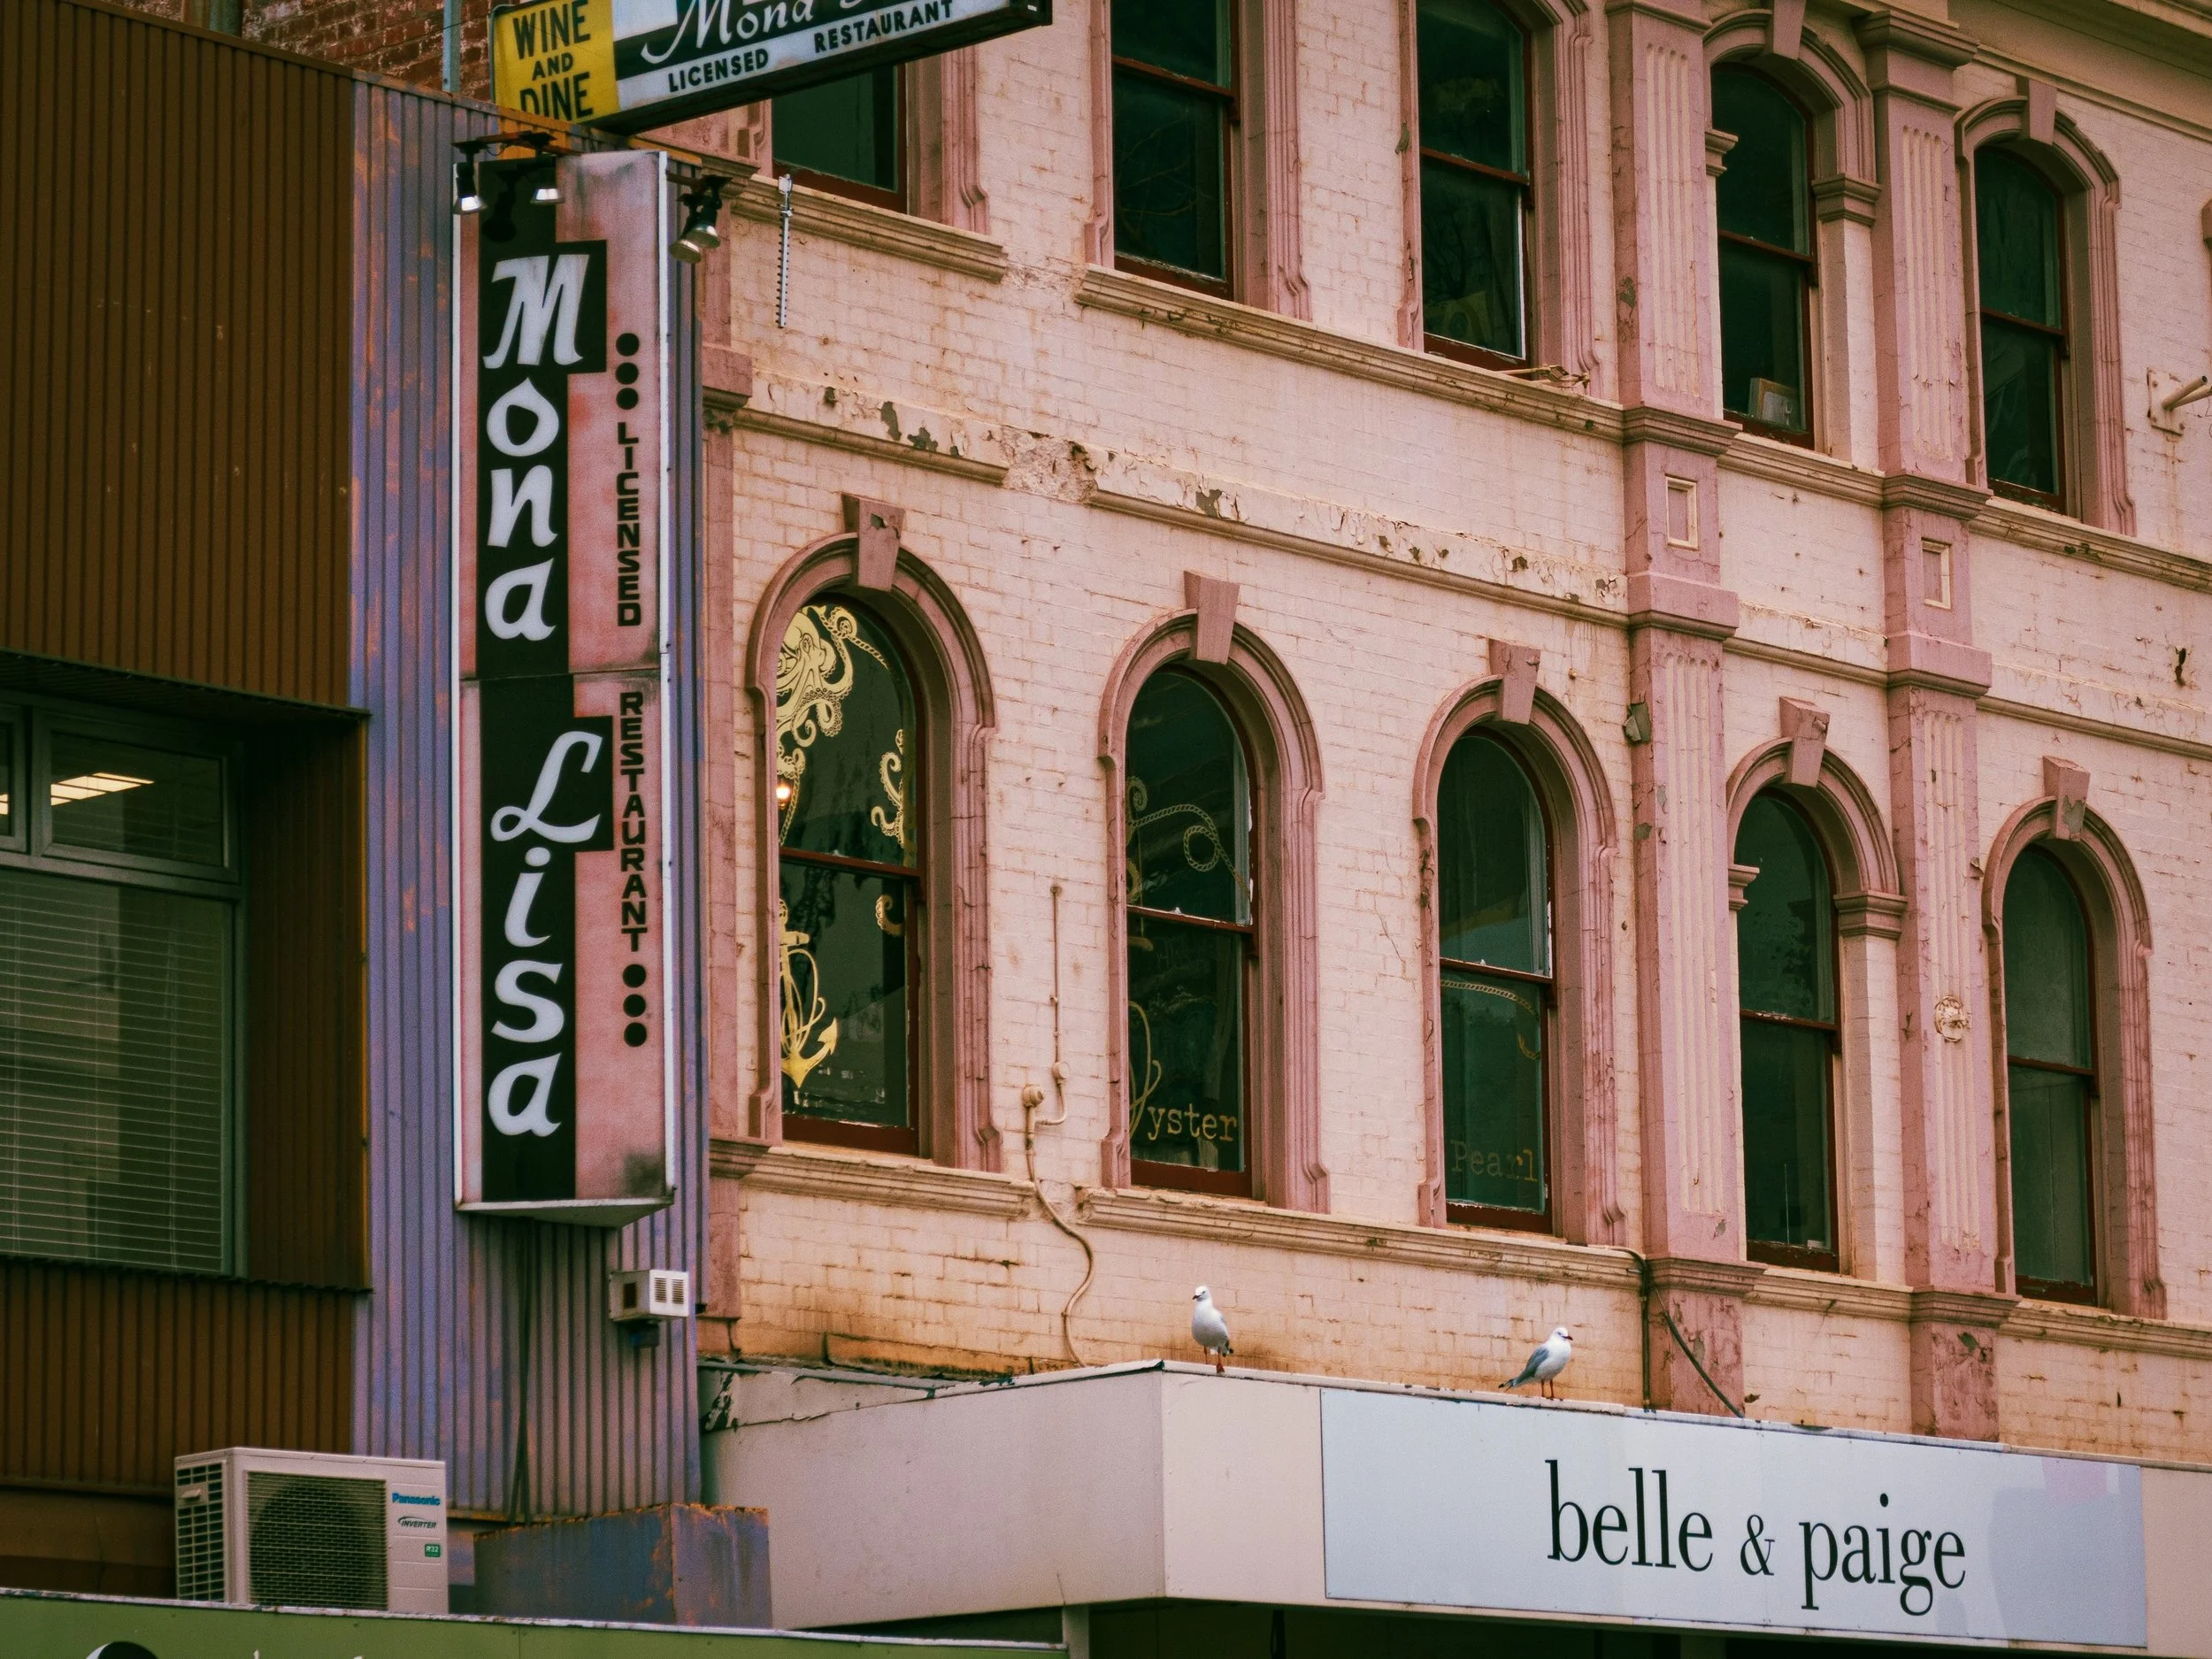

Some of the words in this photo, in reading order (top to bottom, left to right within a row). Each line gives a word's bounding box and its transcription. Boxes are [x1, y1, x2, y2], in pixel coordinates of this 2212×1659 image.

[513, 0, 591, 59] WINE
[532, 52, 573, 81] AND
[641, 0, 813, 64] Mona
[668, 48, 769, 93] LICENSED
[813, 0, 954, 53] RESTAURANT
[519, 72, 594, 121] DINE
[482, 253, 590, 641] Mona
[617, 421, 641, 626] LICENSED
[620, 691, 648, 952] RESTAURANT
[488, 730, 603, 1138] Lisa
[392, 1493, 441, 1506] Panasonic
[401, 1520, 436, 1529] INVERTER
[1545, 1459, 1713, 1573] belle
[1740, 1514, 1775, 1576] &
[1799, 1493, 1966, 1617] paige
